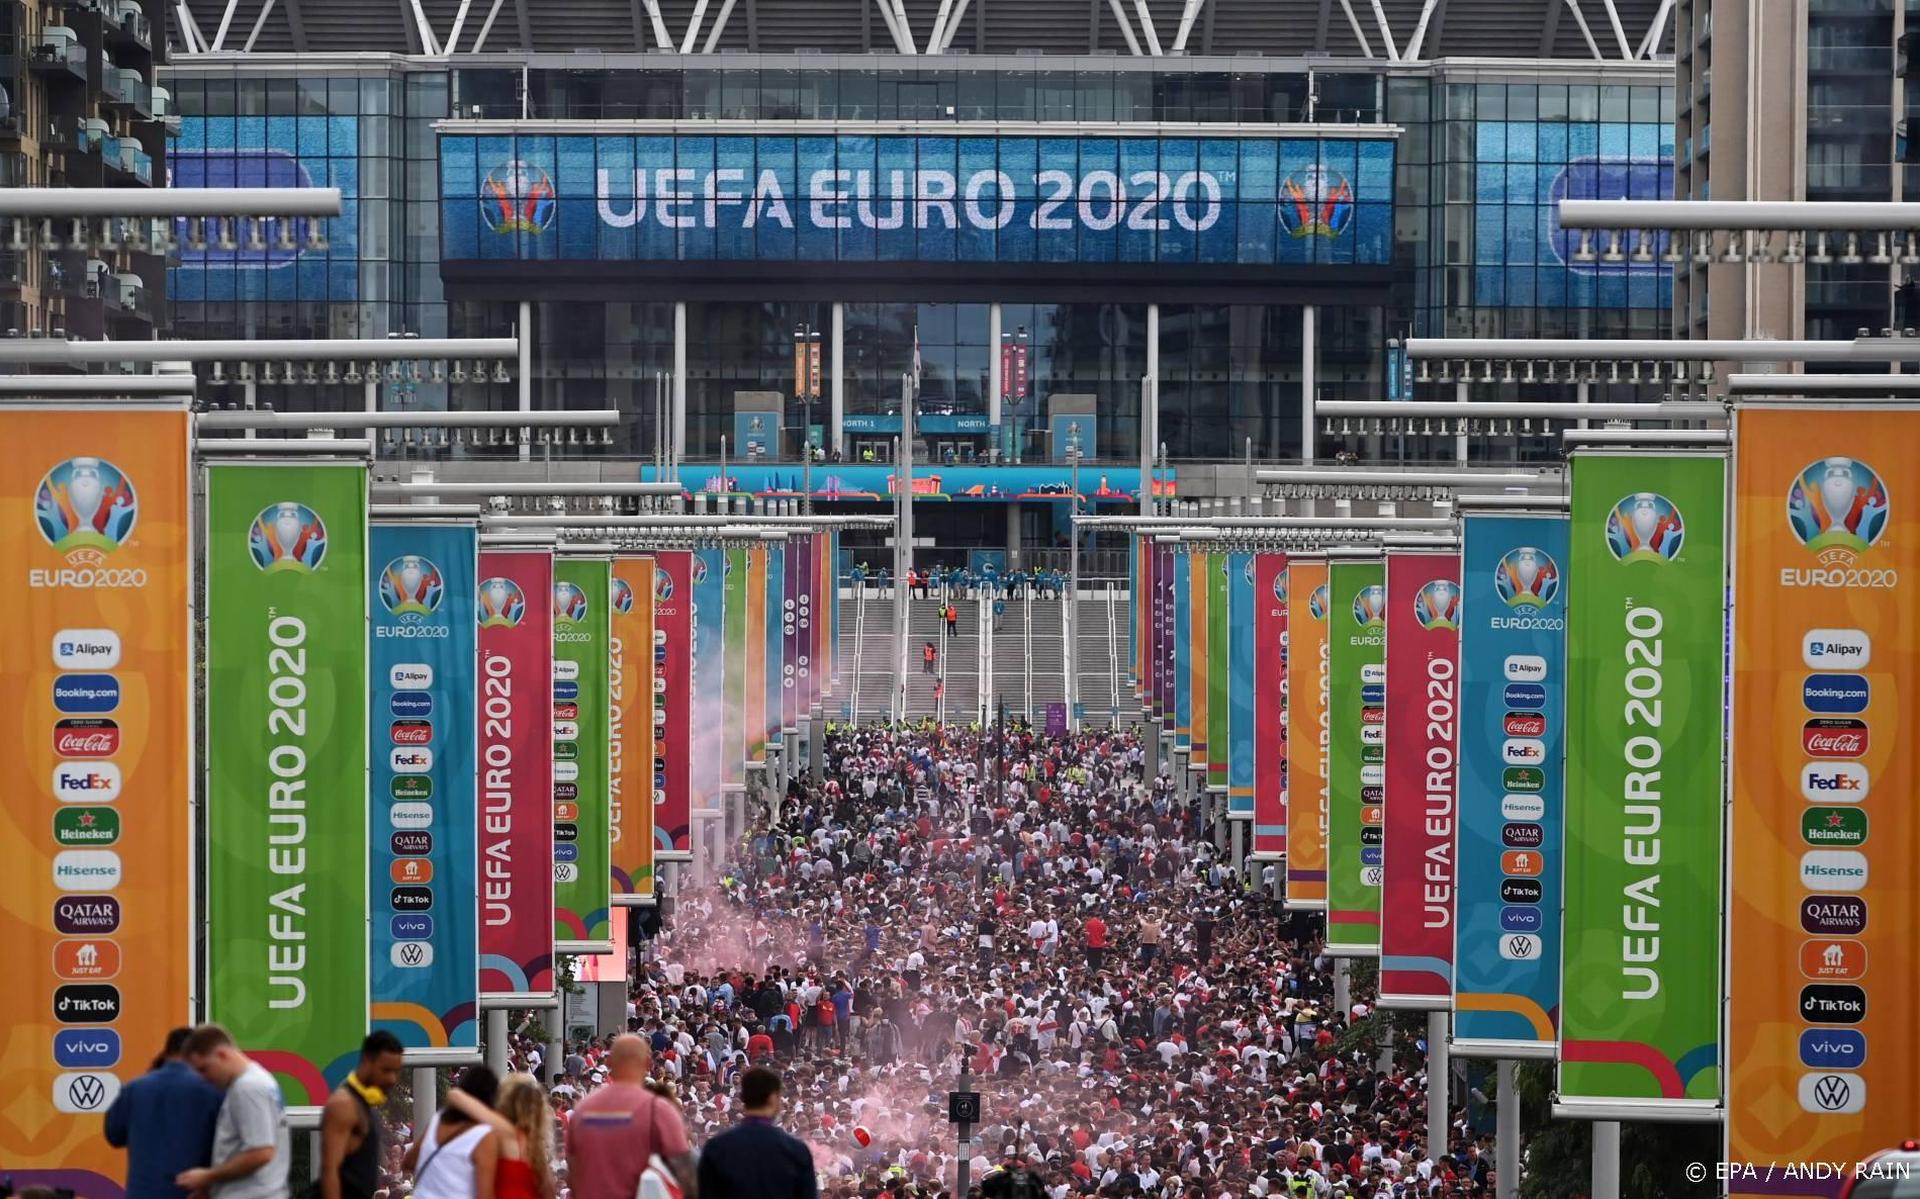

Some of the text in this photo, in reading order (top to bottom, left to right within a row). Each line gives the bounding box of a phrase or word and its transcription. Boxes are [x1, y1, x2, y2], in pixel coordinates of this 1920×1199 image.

[597, 168, 794, 229] UEFA
[810, 169, 1015, 230] EURO
[1029, 169, 1222, 231] 2020
[957, 420, 986, 428] NORTH
[67, 549, 104, 565] UEFA
[1819, 551, 1856, 565] UEFA
[29, 568, 147, 588] EURO2020
[1780, 568, 1897, 588] EURO2020
[1491, 617, 1563, 631] EURO2020
[376, 626, 449, 638] EURO2020
[553, 632, 592, 642] RO2020
[76, 643, 112, 656] Alipay
[1825, 643, 1863, 656] Alipay
[1518, 664, 1542, 673] Alipay
[1624, 607, 1664, 727] 2020
[268, 615, 306, 736] 2020
[404, 672, 428, 681] Alipay
[55, 687, 117, 699] Booking.com
[485, 655, 512, 738] 2020
[1505, 692, 1544, 700] Booking.com
[1805, 687, 1866, 699] Booking.com
[392, 700, 430, 708] Booking.com
[1426, 658, 1454, 741] 2020
[1364, 730, 1384, 738] FedE
[1507, 746, 1540, 757] FedEx
[395, 754, 427, 765] FedEx
[61, 773, 111, 790] FedEx
[1506, 780, 1540, 788] Heineken
[1809, 773, 1861, 790] FedEx
[395, 788, 428, 796] Heineken
[485, 744, 512, 833] EURO
[1363, 789, 1383, 797] QATA
[1425, 746, 1453, 836] EURO
[1623, 736, 1663, 865] EURO
[268, 745, 306, 875] EURO
[1504, 803, 1542, 812] Hisense
[393, 811, 430, 819] Hisense
[60, 829, 114, 839] Heineken
[1505, 827, 1539, 838] QATAR
[1808, 829, 1861, 840] Heineken
[395, 836, 428, 847] QATAR
[57, 865, 117, 876] Hisense
[1804, 865, 1864, 877] Hisense
[485, 839, 512, 926] UEFA
[1424, 842, 1451, 928] UEFA
[1513, 888, 1539, 896] TikTok
[403, 896, 429, 904] TikTok
[60, 904, 113, 919] QATAR
[1807, 903, 1860, 919] QATAR
[72, 916, 114, 926] AIRWAYS
[1507, 914, 1535, 923] vivo
[1819, 917, 1860, 926] AIRWAYS
[399, 922, 426, 930] vivo
[1622, 873, 1662, 1000] UEFA
[268, 883, 306, 1009] UEFA
[72, 1000, 116, 1011] TikTok
[1818, 999, 1861, 1012] TikTok
[65, 1041, 109, 1053] vivo
[1811, 1041, 1855, 1054] vivo
